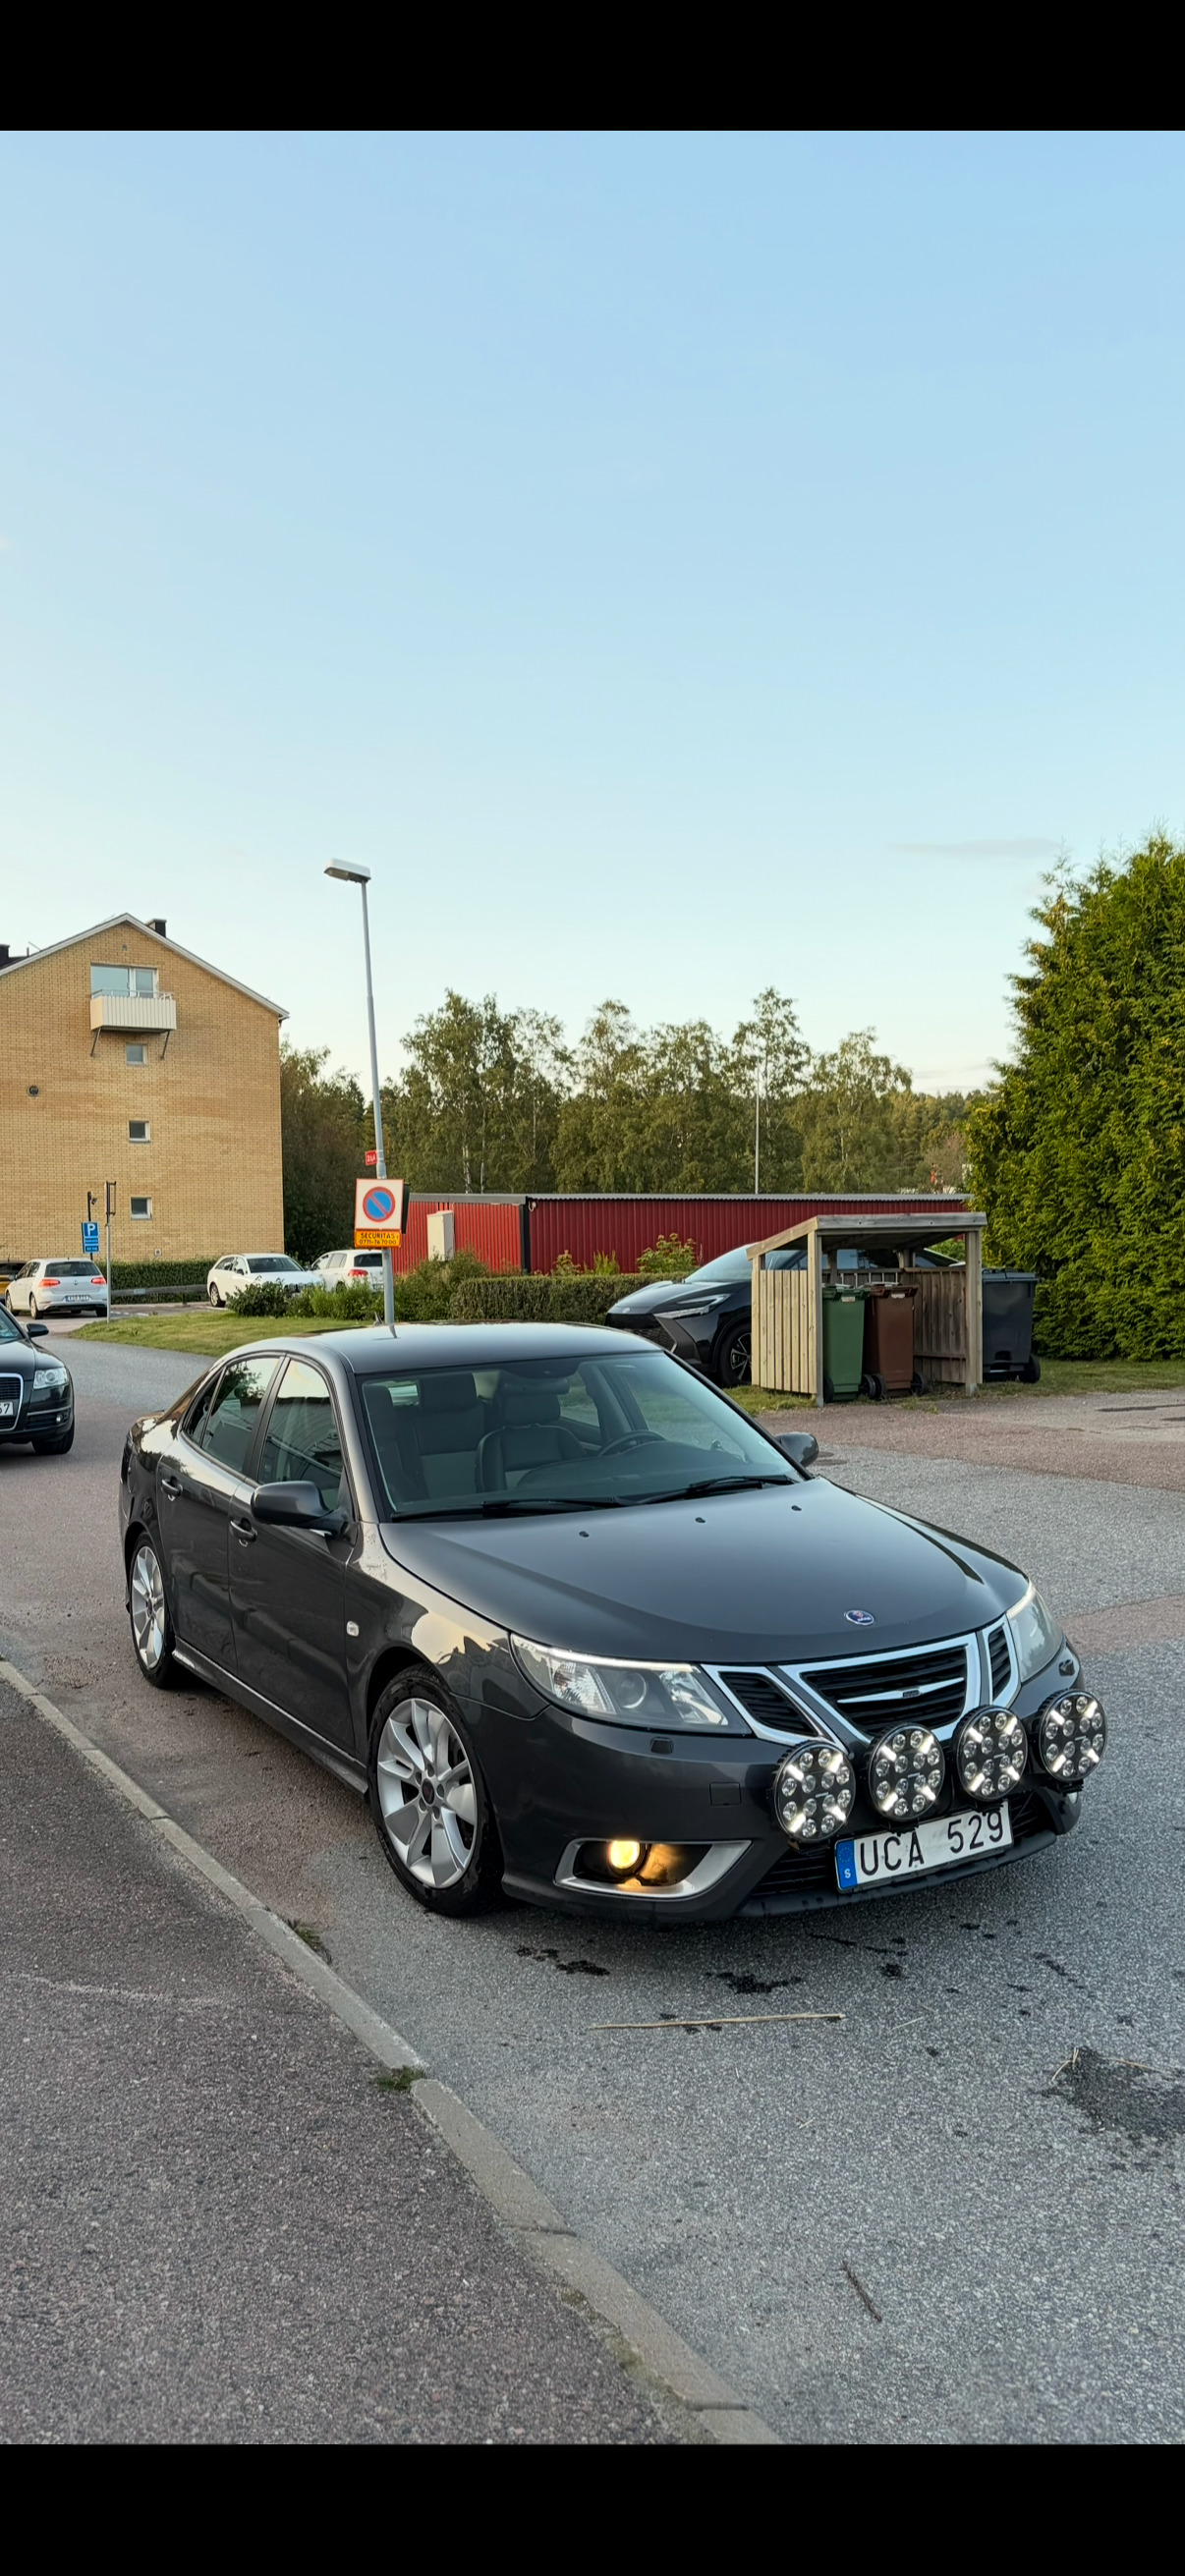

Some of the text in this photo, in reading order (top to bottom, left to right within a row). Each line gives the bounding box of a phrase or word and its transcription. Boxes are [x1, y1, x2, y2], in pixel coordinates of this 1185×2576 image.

[86, 1223, 96, 1236] P
[860, 1810, 1003, 1876] UCA 529
[843, 1868, 852, 1879] S
